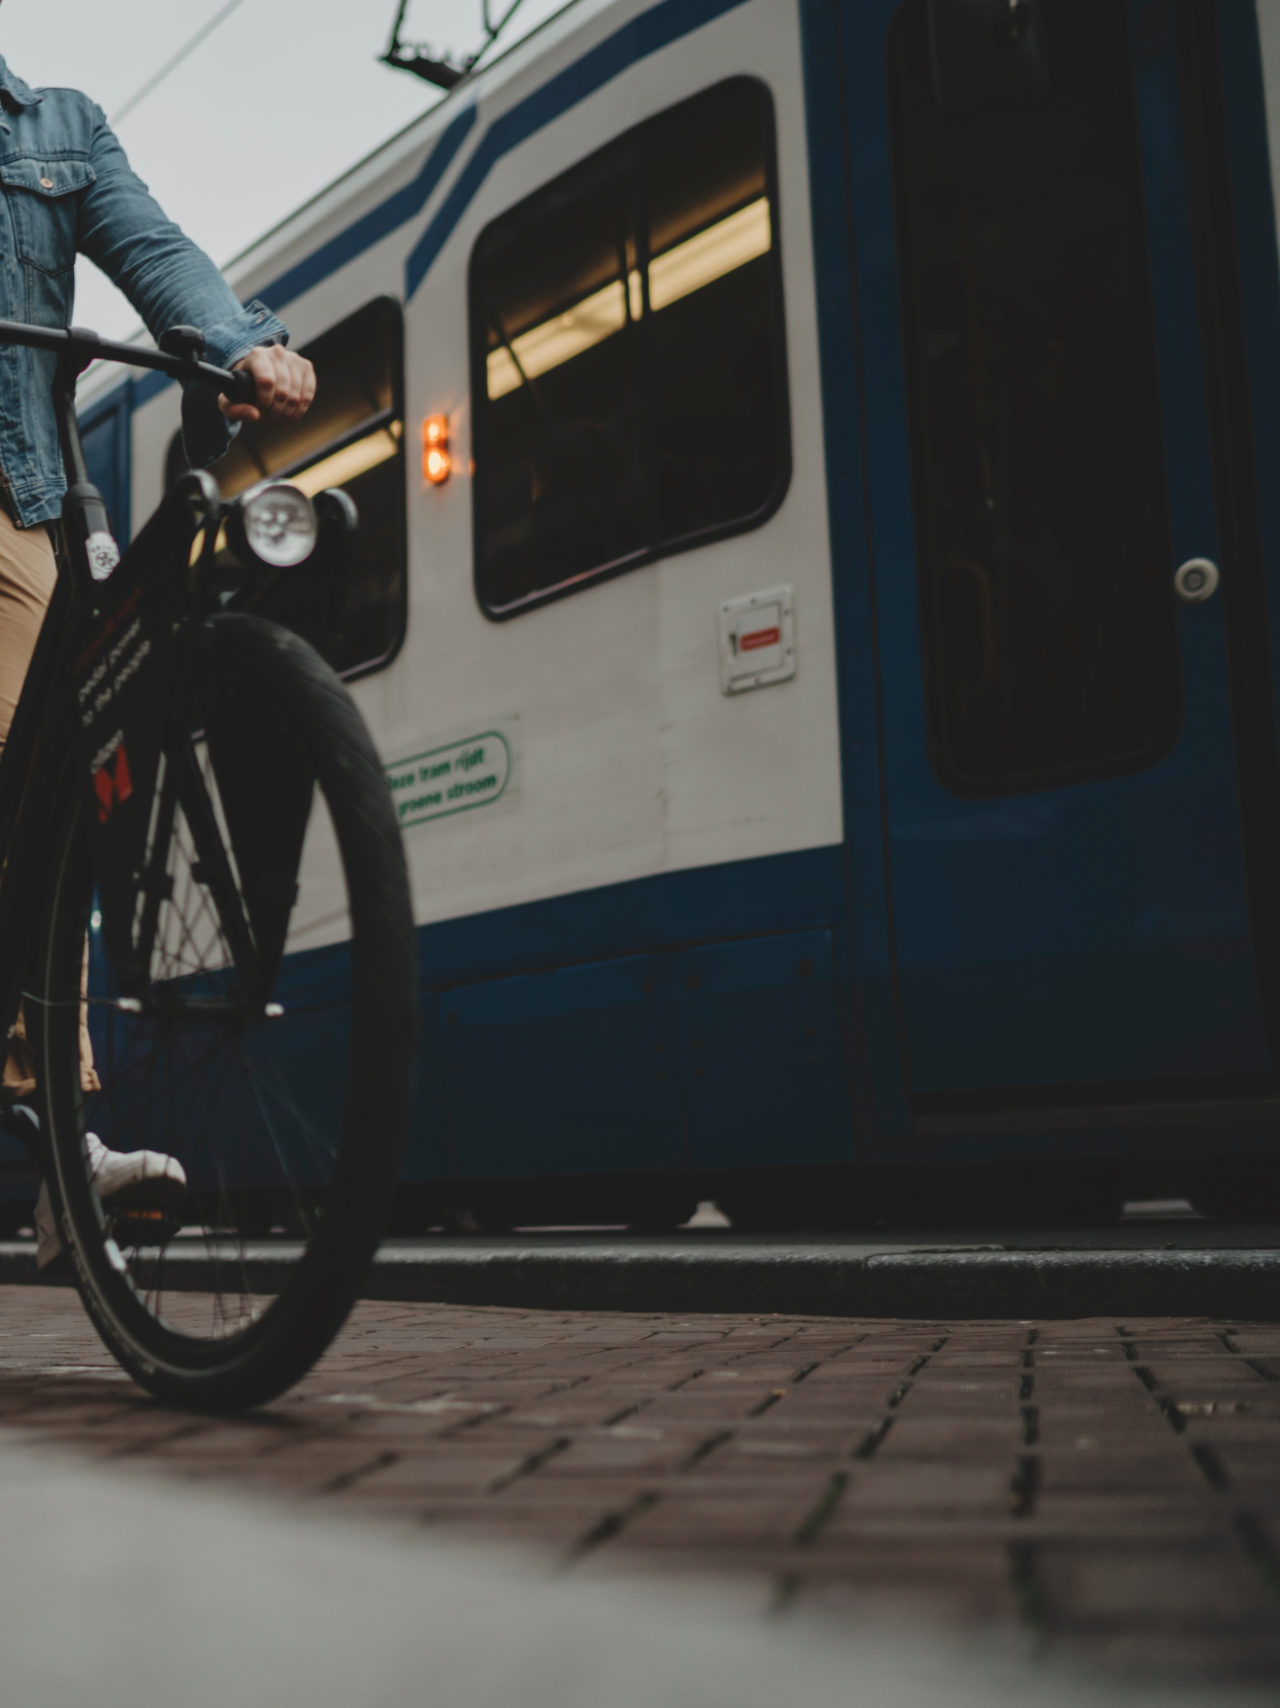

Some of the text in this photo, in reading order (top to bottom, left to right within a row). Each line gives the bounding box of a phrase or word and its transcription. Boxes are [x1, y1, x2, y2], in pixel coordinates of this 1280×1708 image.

[419, 762, 450, 782] tram
[455, 747, 485, 772] rijdt
[447, 773, 497, 800] stroom
